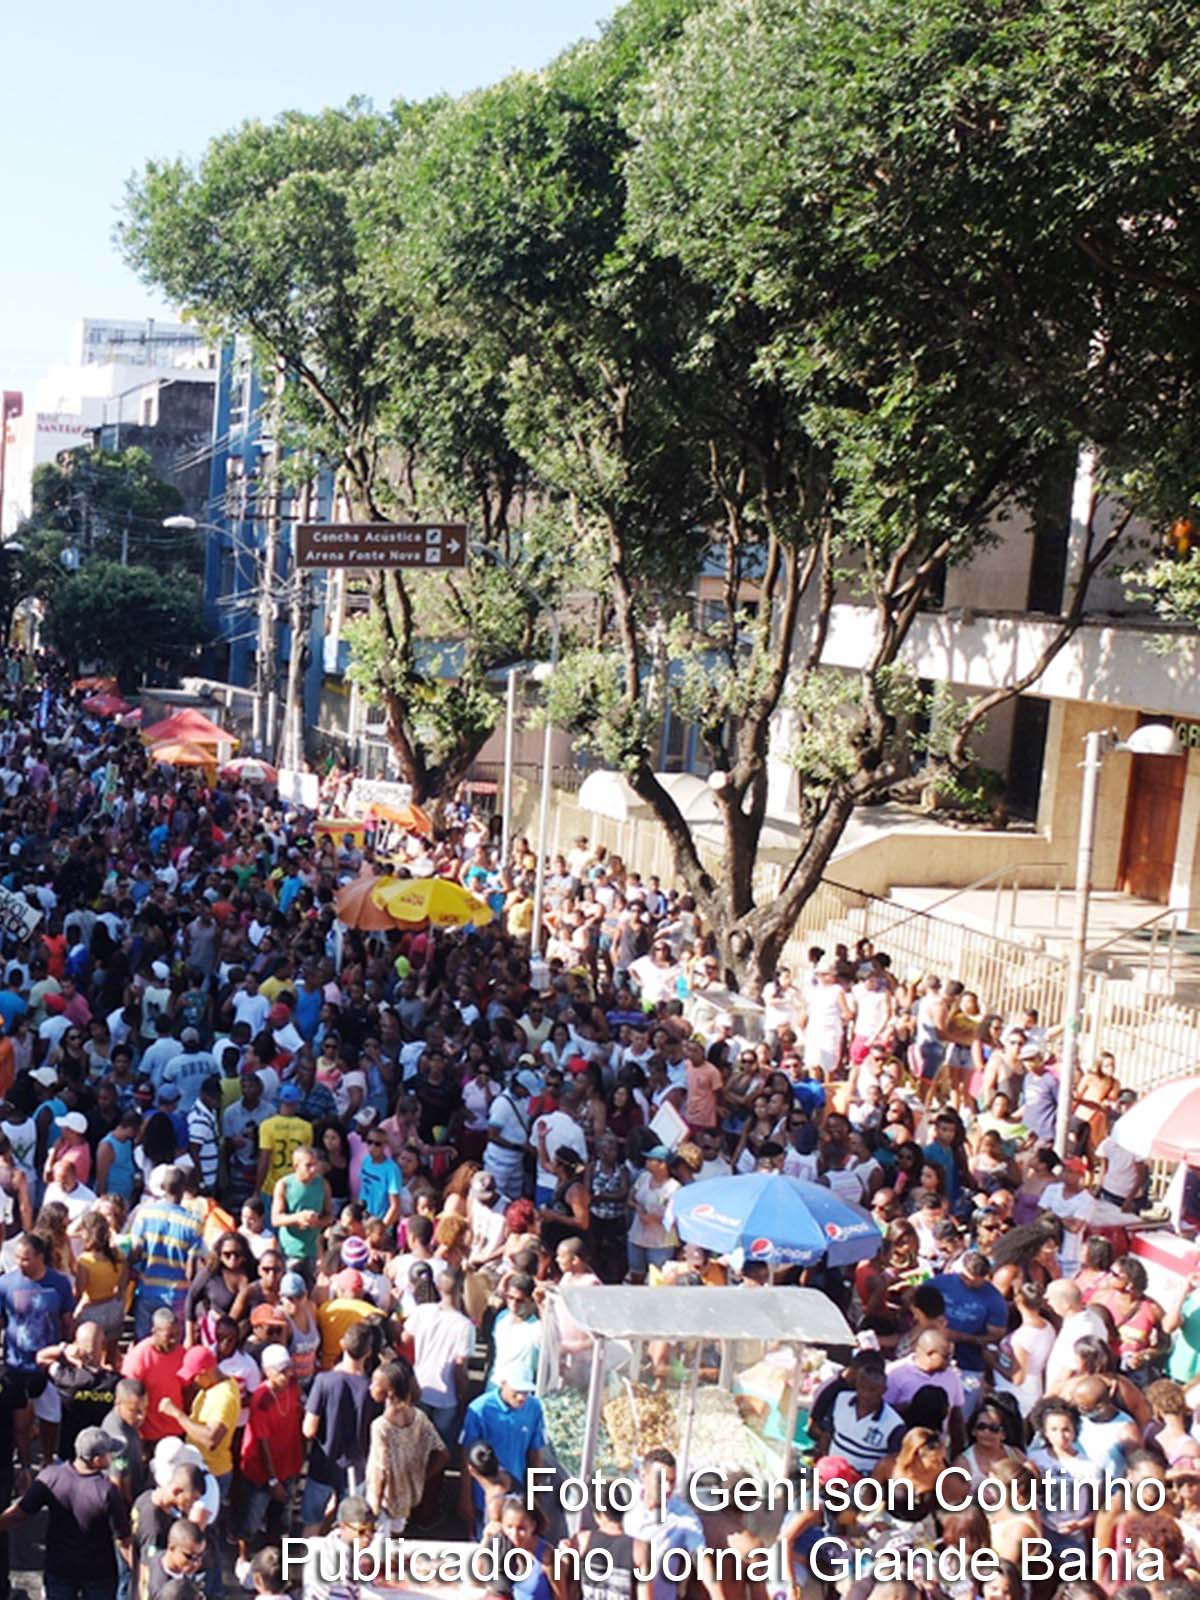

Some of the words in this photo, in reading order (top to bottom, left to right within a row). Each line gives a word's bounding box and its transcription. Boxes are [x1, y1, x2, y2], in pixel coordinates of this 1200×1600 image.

[312, 531, 360, 543] Concha
[364, 530, 422, 543] Acústica
[305, 550, 344, 561] Arena
[349, 550, 385, 561] Fonte
[389, 550, 421, 561] Nova
[73, 1389, 114, 1403] APOIO
